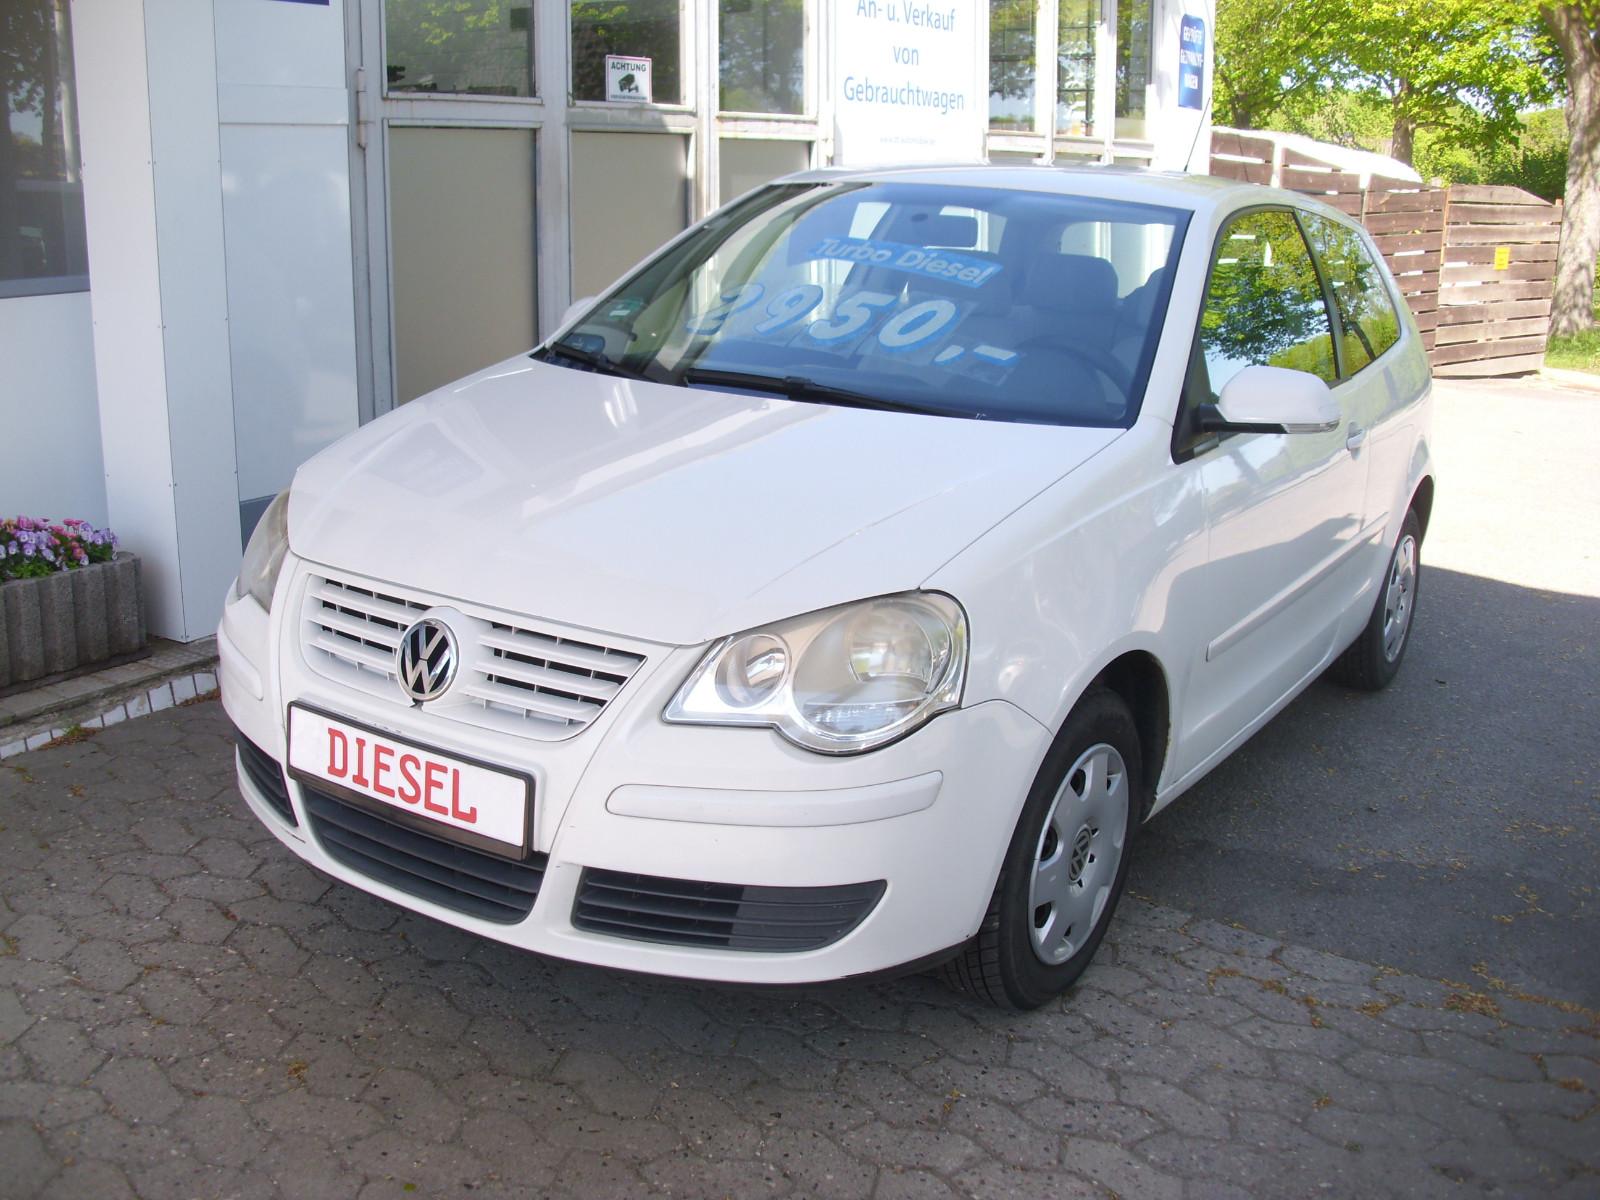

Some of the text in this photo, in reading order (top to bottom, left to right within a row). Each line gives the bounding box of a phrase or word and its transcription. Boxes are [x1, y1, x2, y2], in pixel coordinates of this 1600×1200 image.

[857, 0, 955, 32] An- u. Verkauf
[611, 61, 646, 72] ACHTUNG
[893, 46, 919, 66] von
[844, 76, 964, 115] Gebrauchtwagen
[816, 238, 995, 284] Turbo Diesel
[328, 727, 477, 824] DIESEL
